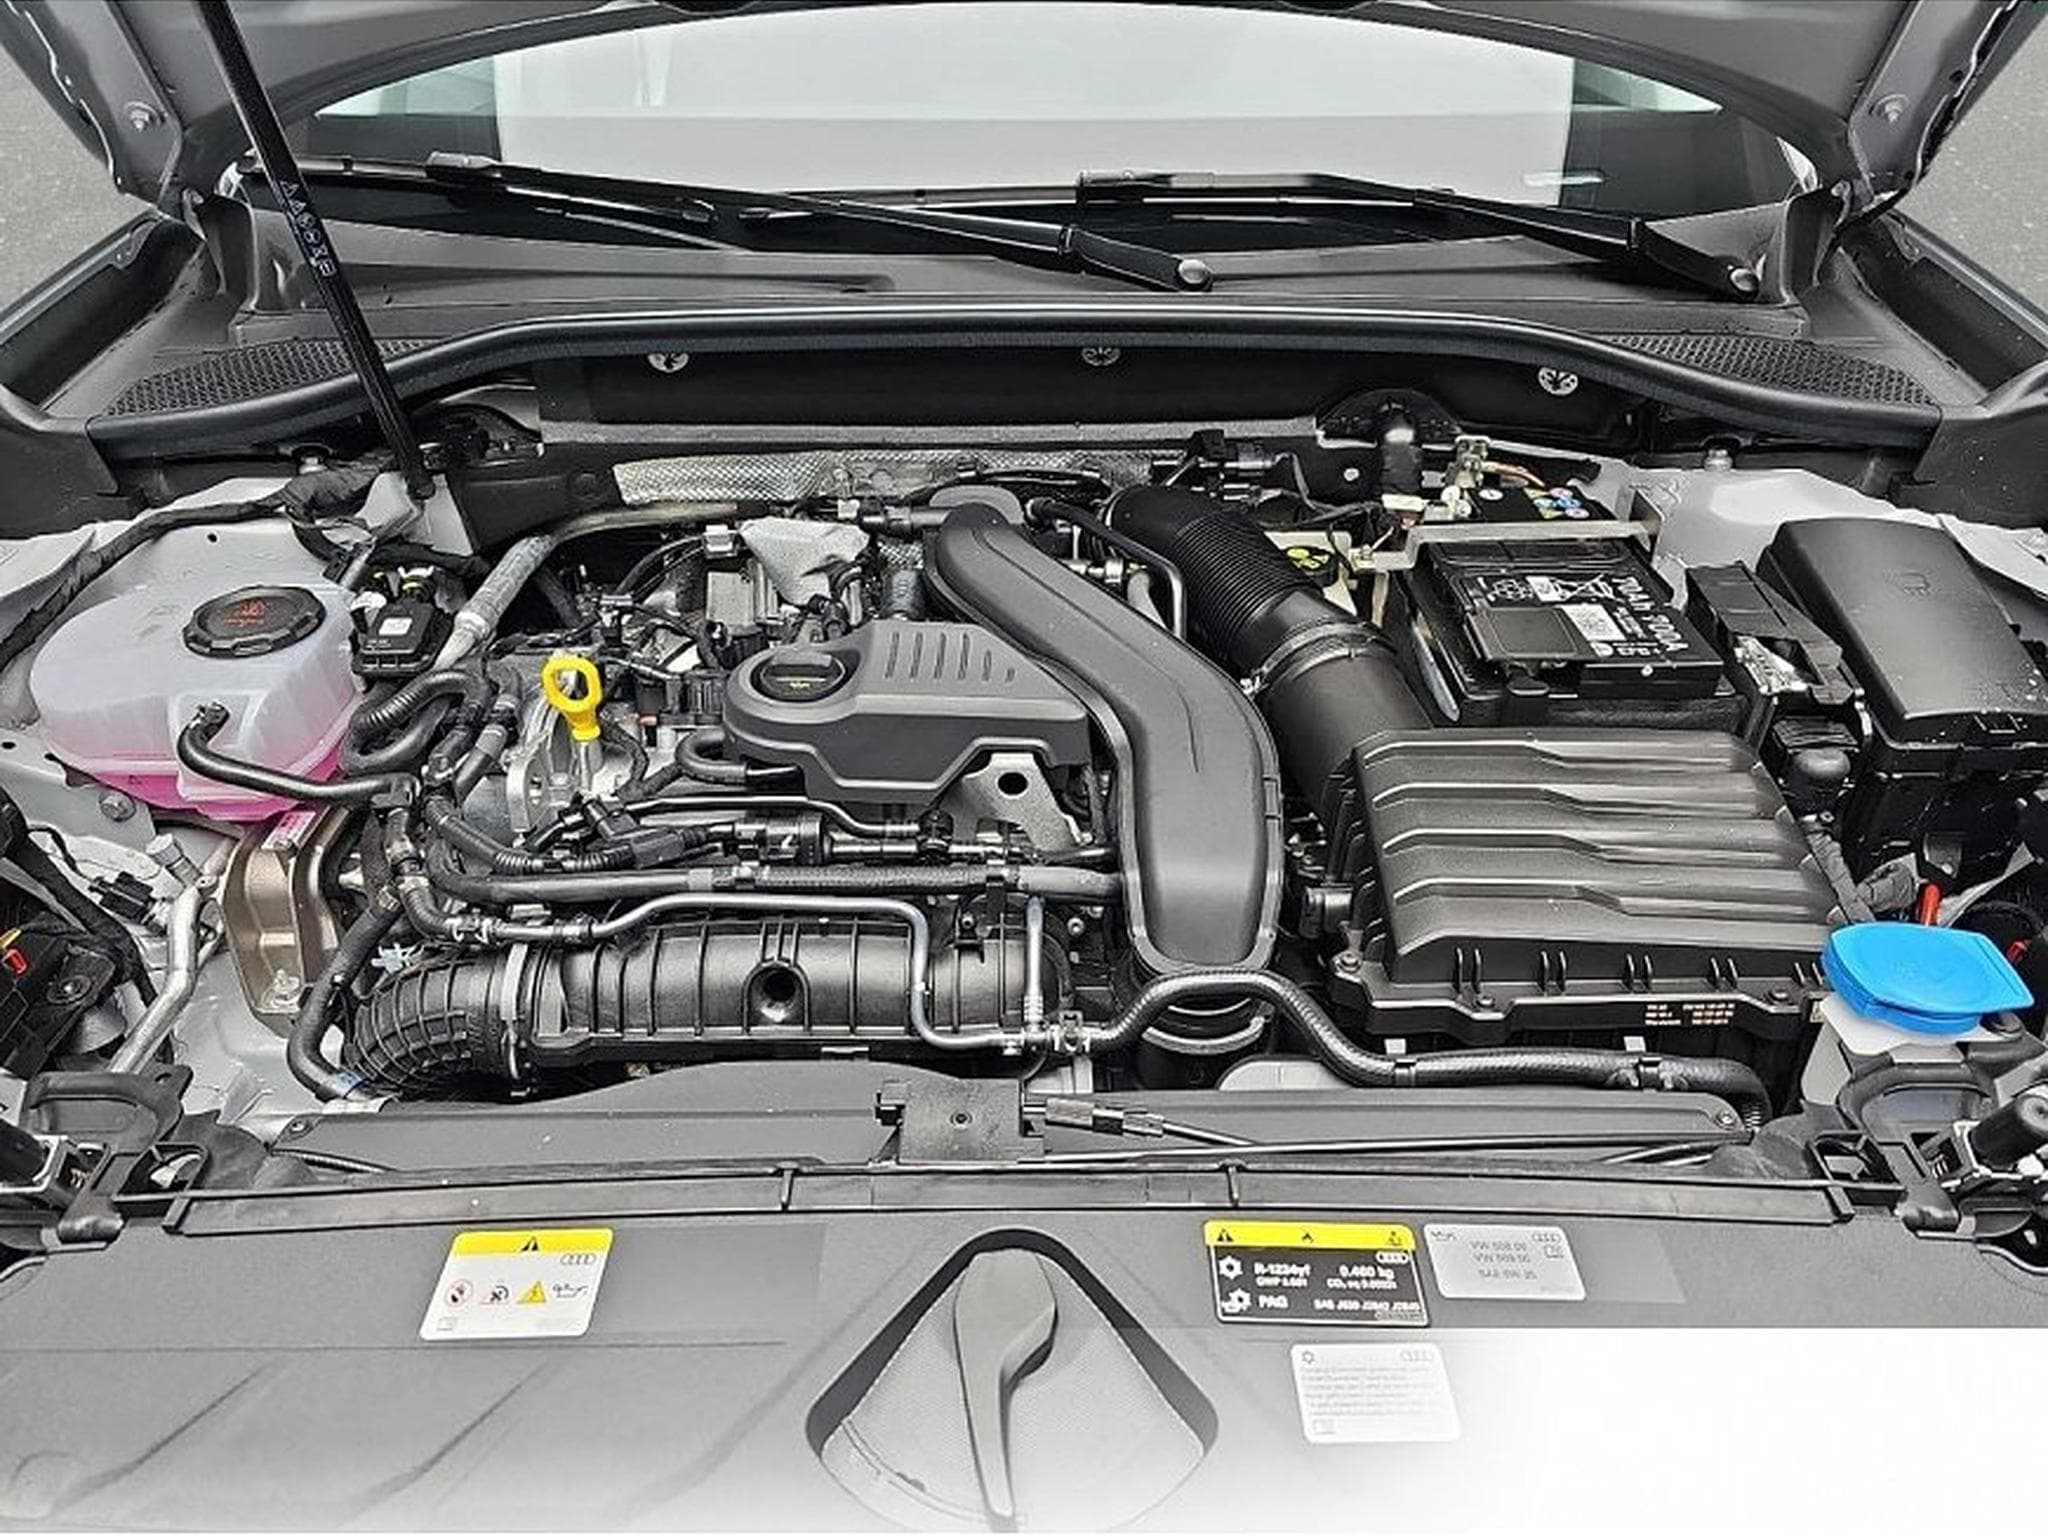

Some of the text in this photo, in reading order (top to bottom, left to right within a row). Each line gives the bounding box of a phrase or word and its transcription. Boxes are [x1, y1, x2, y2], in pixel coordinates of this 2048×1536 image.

[1254, 1262, 1311, 1278] R-1234yf
[1377, 1264, 1396, 1280] kg
[1258, 1295, 1289, 1309] PAG
